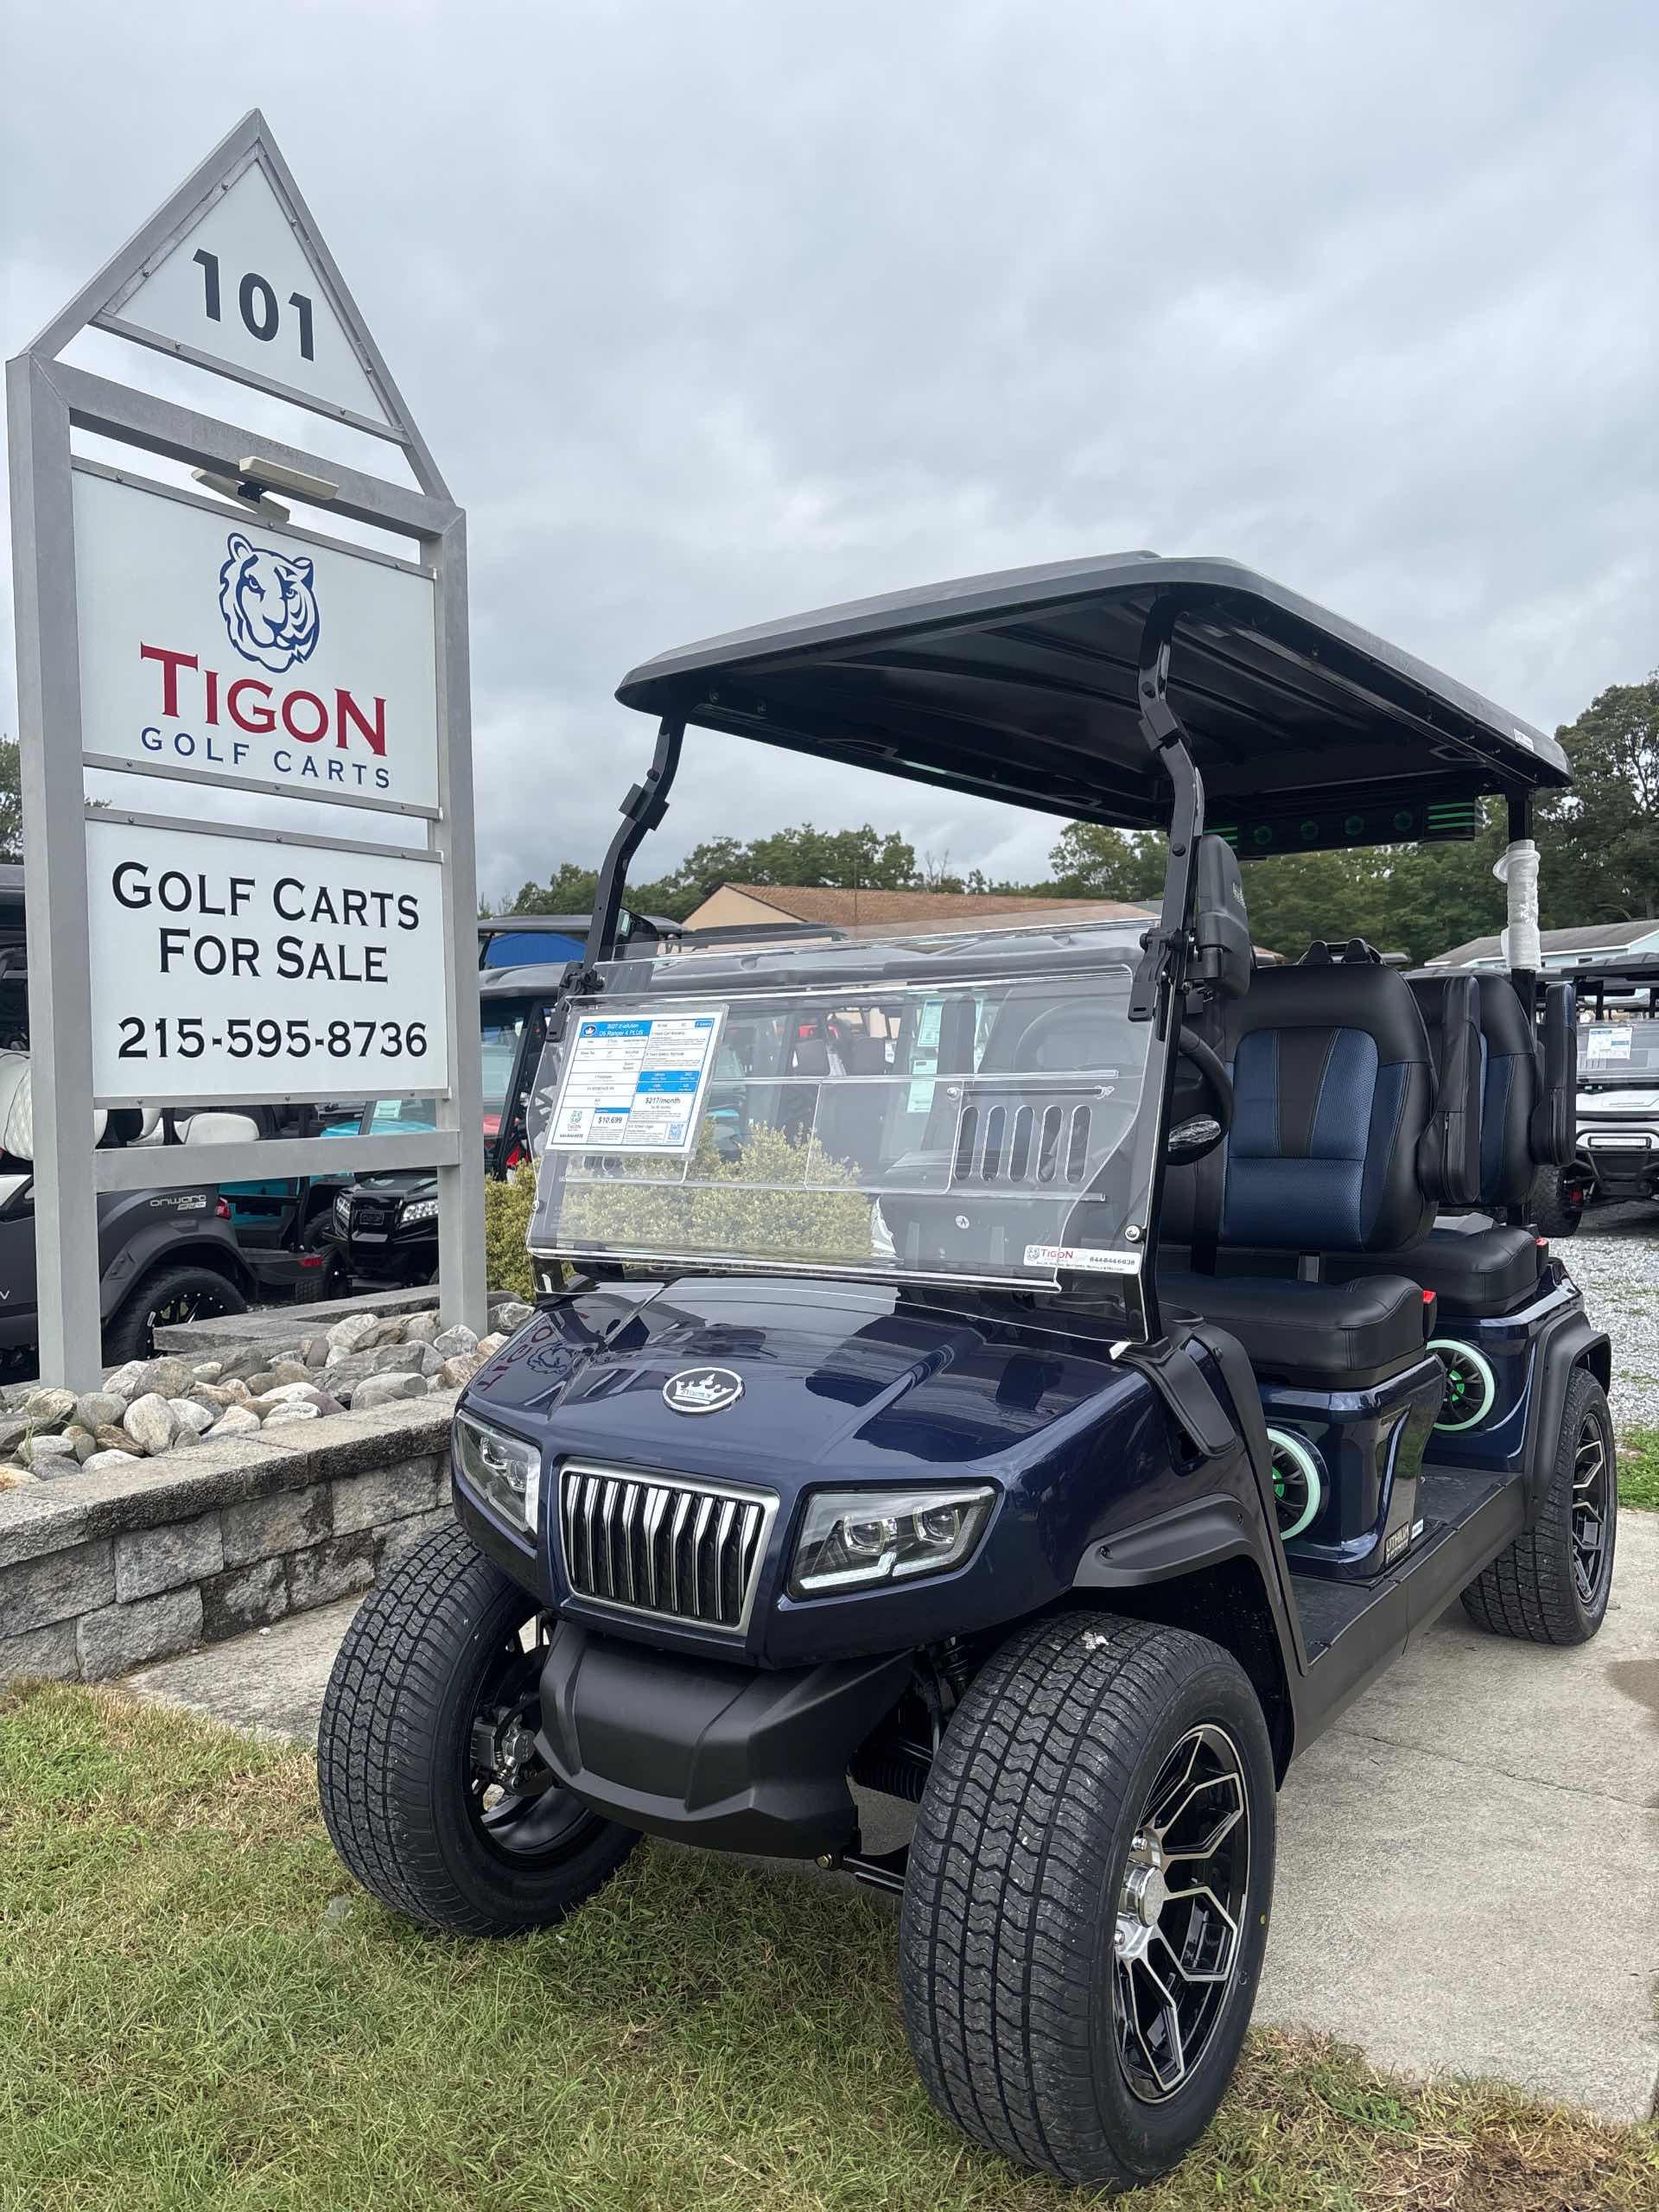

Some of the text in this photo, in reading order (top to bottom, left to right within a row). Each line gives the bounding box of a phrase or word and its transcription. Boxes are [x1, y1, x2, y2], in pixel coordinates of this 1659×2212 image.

[193, 248, 315, 362] 101
[140, 641, 388, 757] TIGON
[141, 727, 391, 789] GOLF CARTS
[111, 861, 420, 931] GOLF CARTS
[158, 927, 389, 983] FOR SALE
[118, 1016, 428, 1059] 215-595-8736
[1040, 1249, 1074, 1260] TIGON
